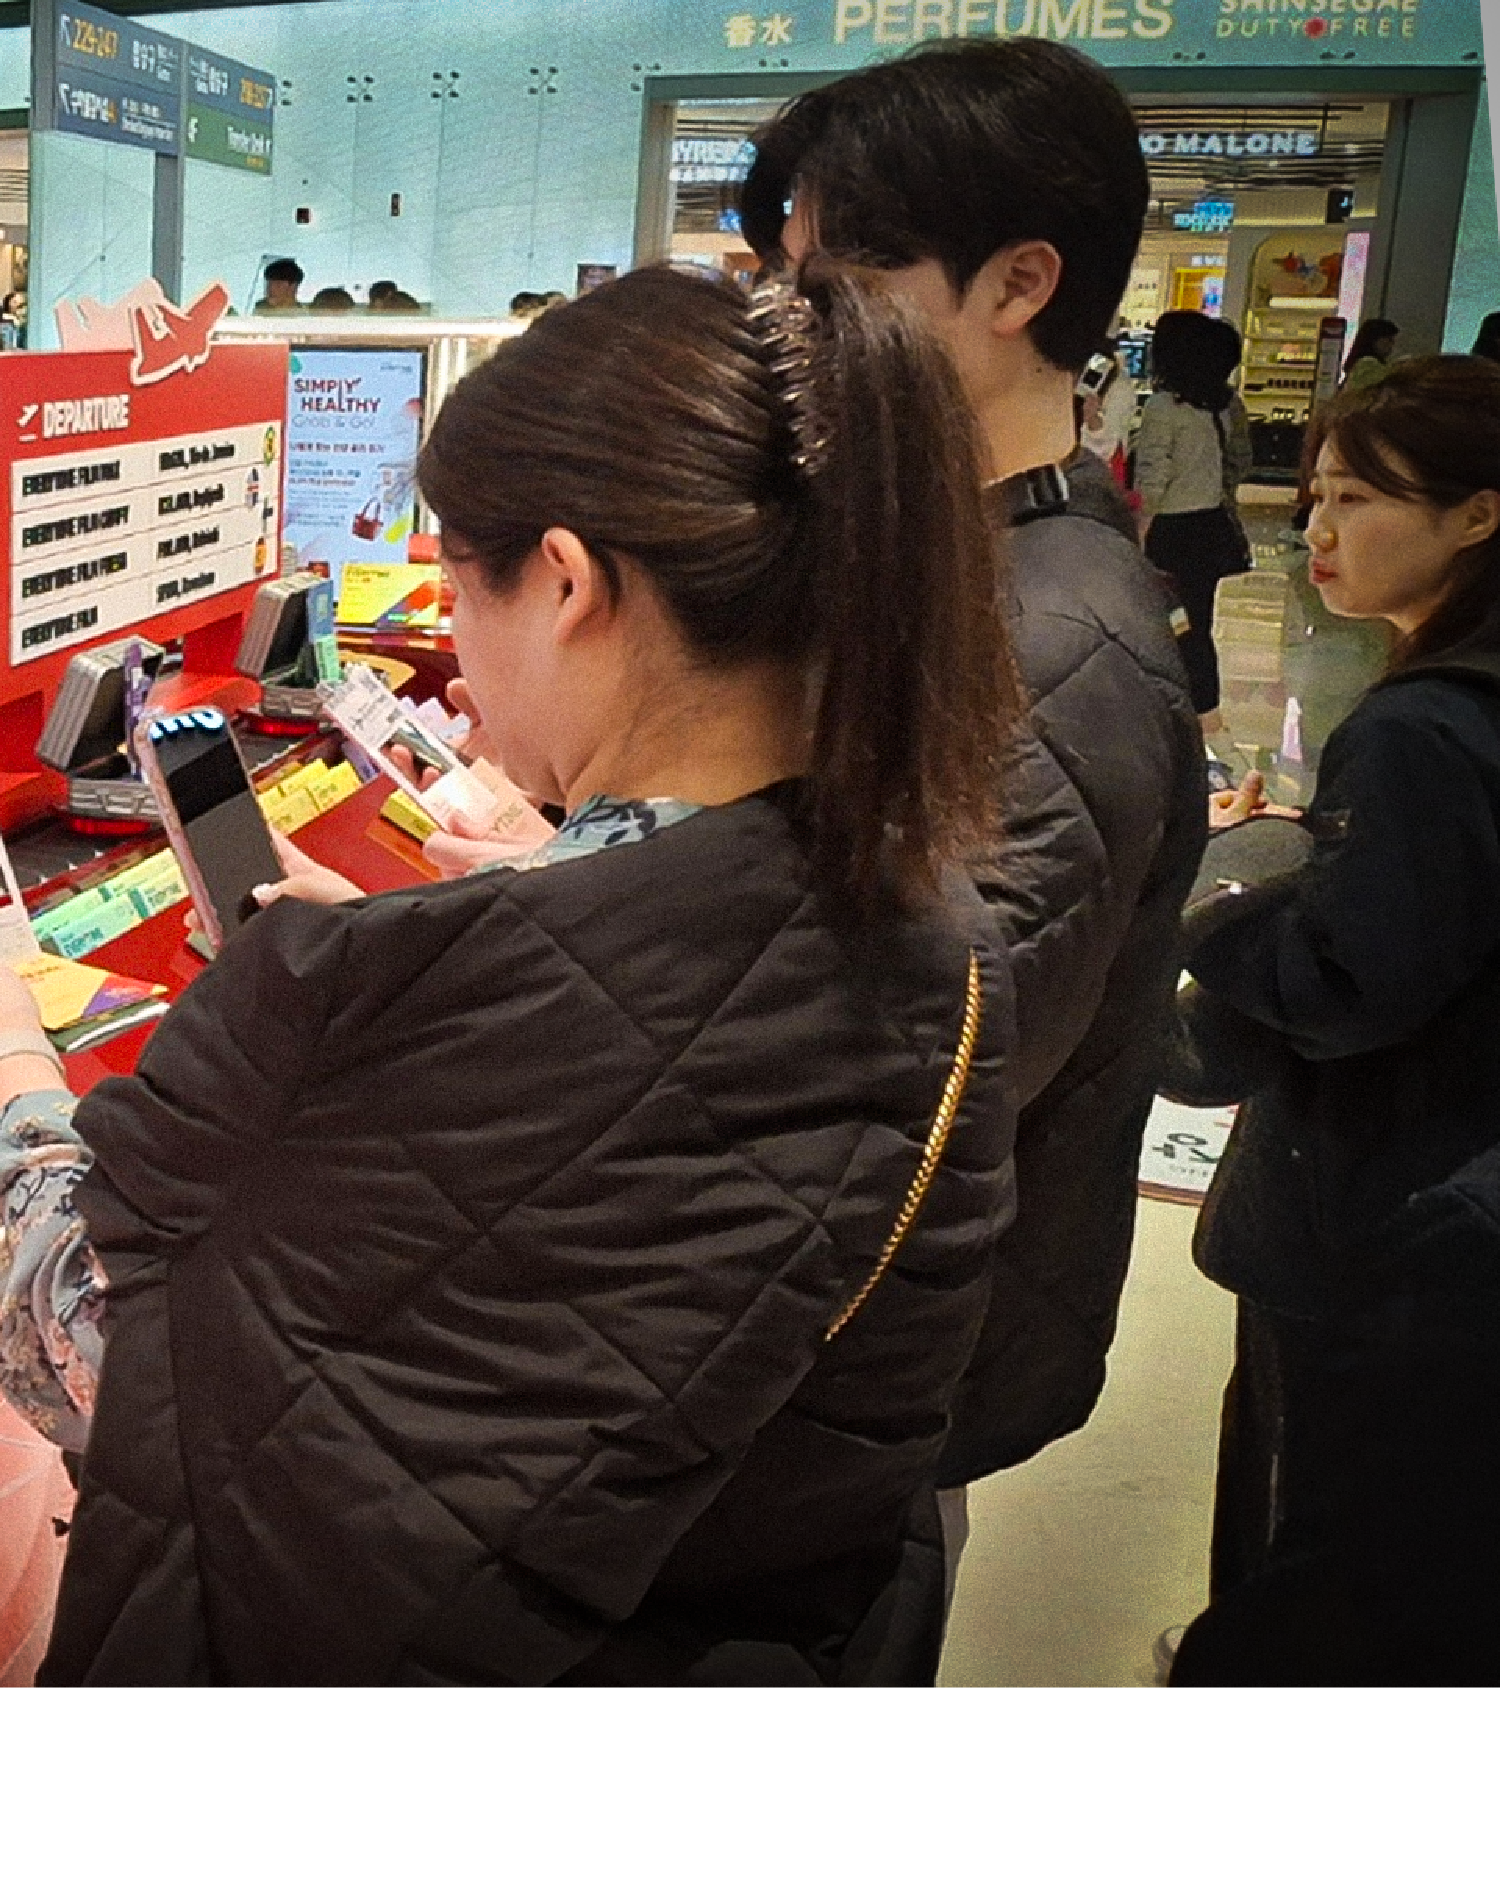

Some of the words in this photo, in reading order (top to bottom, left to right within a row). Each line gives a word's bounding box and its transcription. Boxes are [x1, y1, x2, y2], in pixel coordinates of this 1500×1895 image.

[723, 16, 792, 48] 香水
[835, 0, 1175, 44] PERFUMES
[1216, 18, 1302, 39] DUTY
[1330, 17, 1415, 38] FREE
[1174, 132, 1317, 155] MALONE
[293, 377, 362, 395] SIMPLY
[42, 394, 130, 438] DEPARTURE
[301, 396, 381, 413] HEALTHY
